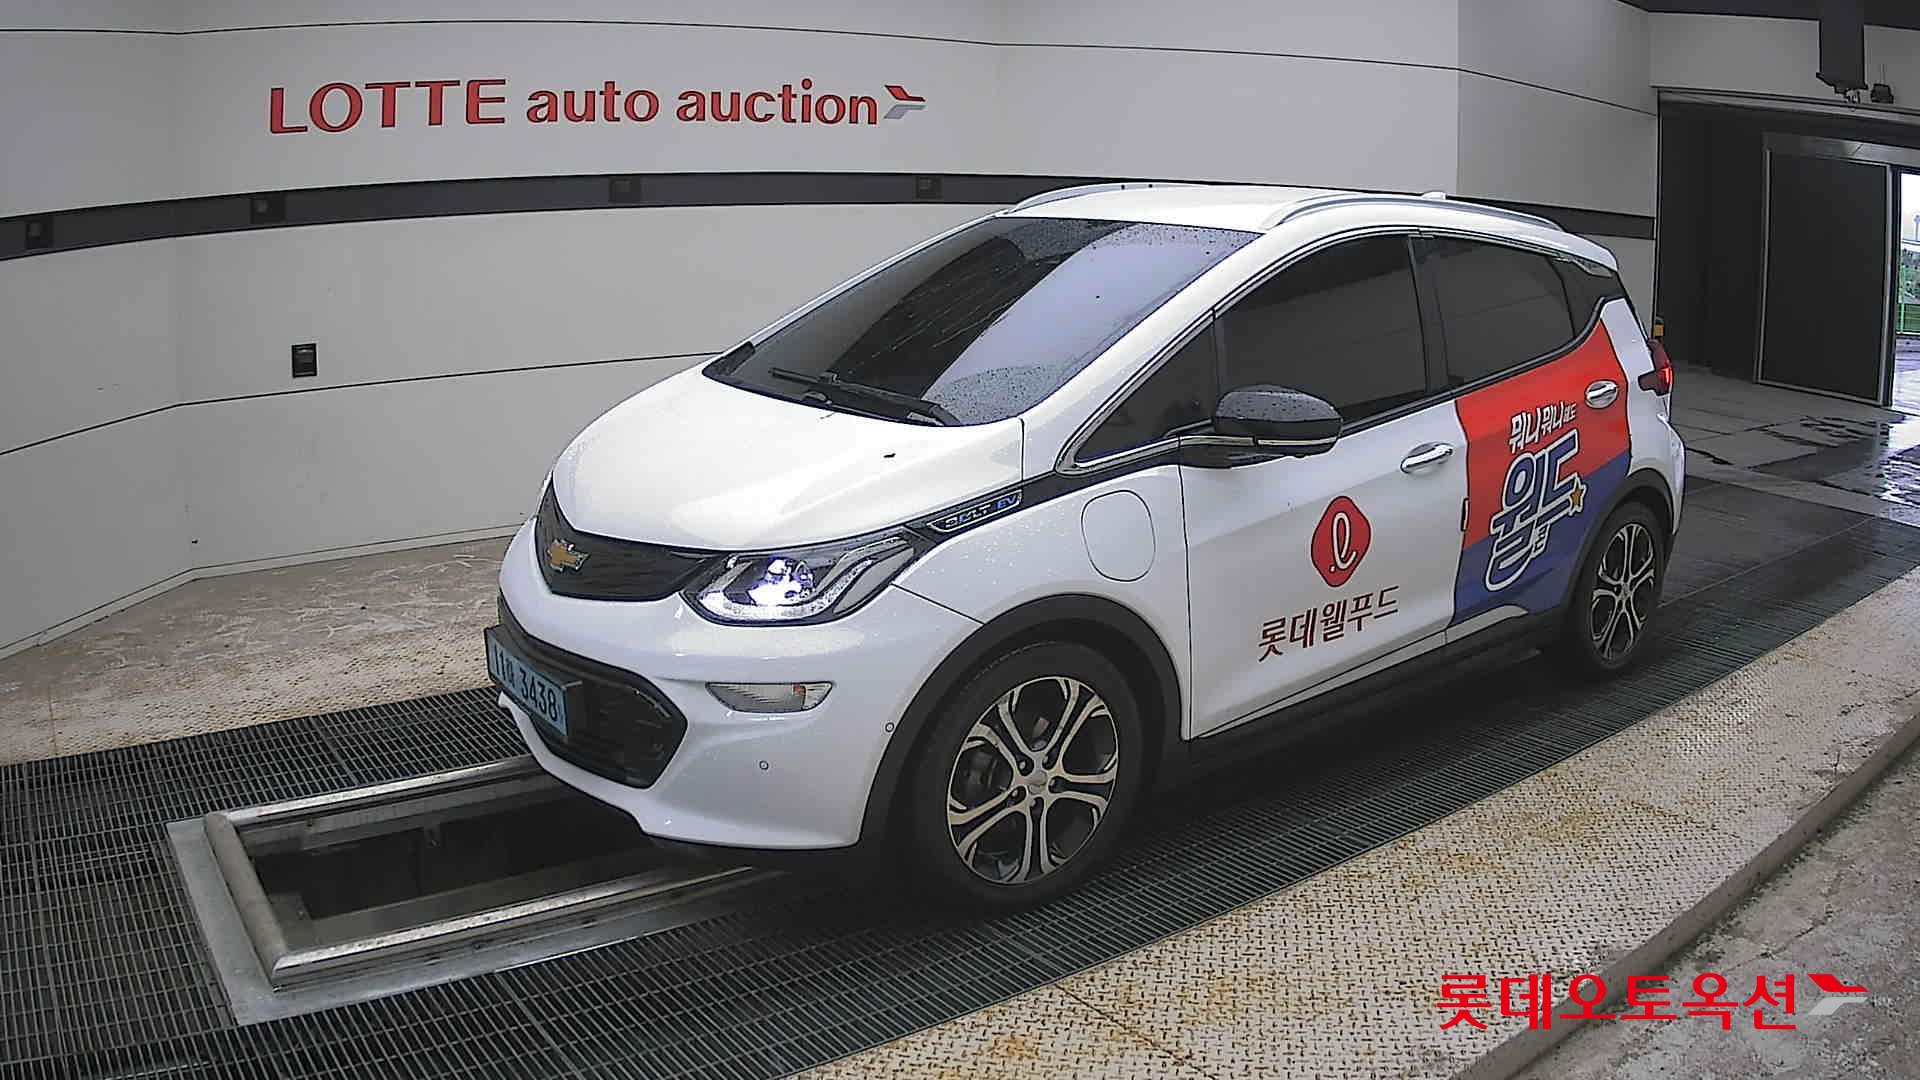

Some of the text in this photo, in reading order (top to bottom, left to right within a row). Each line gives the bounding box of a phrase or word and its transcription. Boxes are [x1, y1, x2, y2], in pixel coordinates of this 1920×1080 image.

[269, 78, 878, 134] LOTTE auto auction
[997, 493, 1017, 509] EV
[1258, 586, 1399, 662] 롯데웰푸드
[519, 666, 558, 722] 3438
